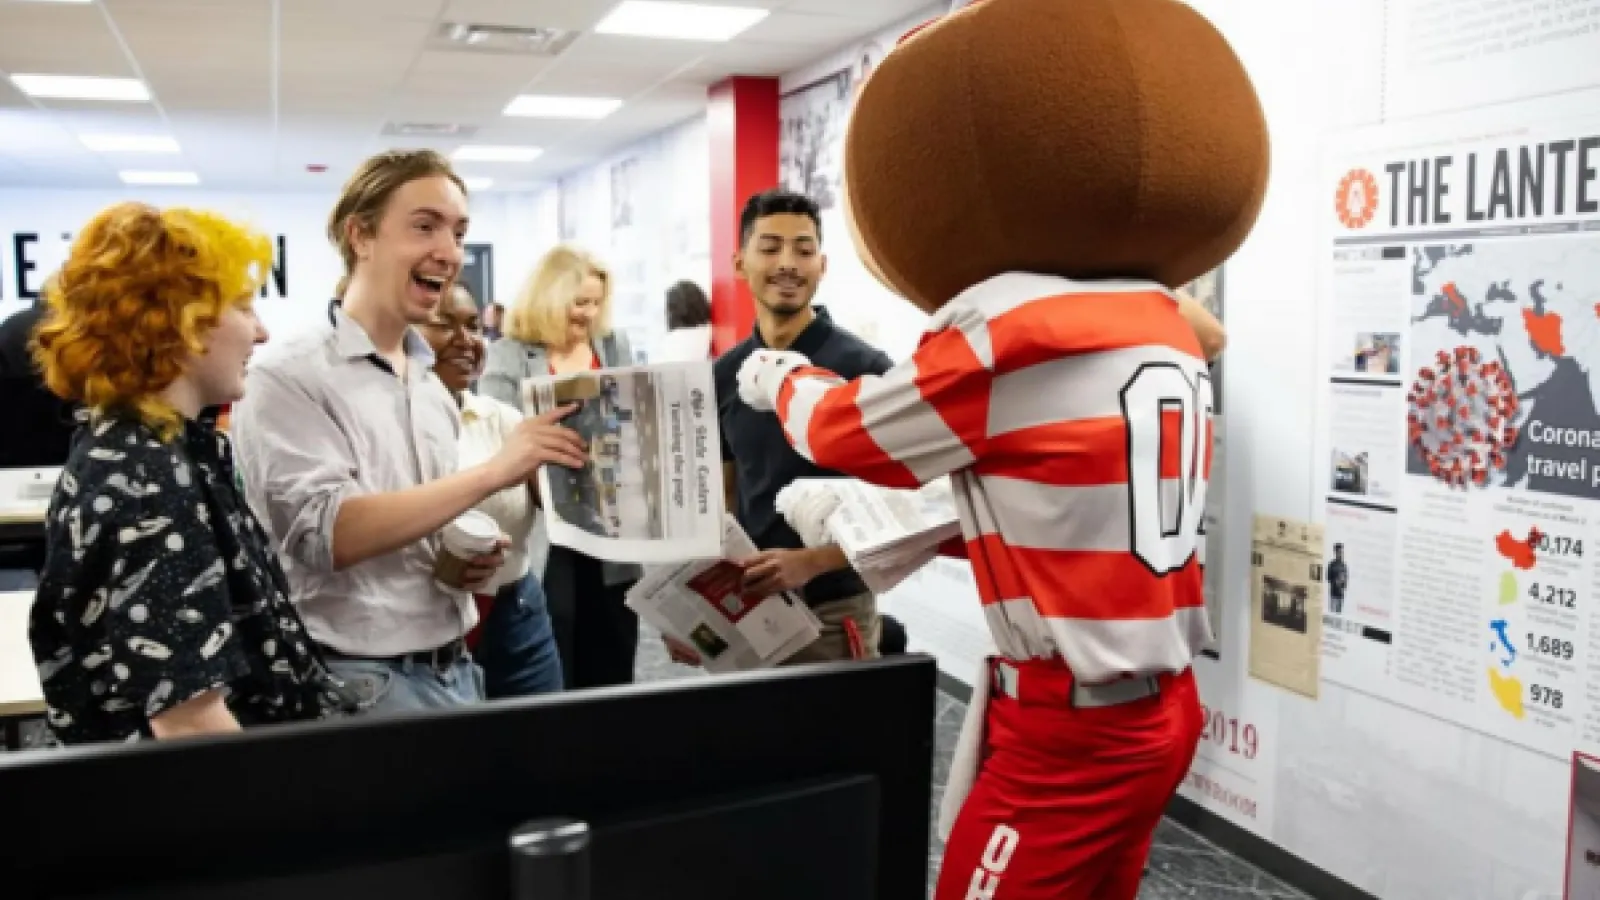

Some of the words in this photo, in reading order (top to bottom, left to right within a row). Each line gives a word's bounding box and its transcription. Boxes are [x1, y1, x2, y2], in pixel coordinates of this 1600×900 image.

[1384, 155, 1453, 228] THE
[1466, 135, 1600, 222] LANTE
[670, 402, 683, 453] Turning
[1527, 419, 1600, 447] Corona
[674, 454, 685, 474] the
[1526, 454, 1587, 480] travel
[671, 478, 684, 509] page
[1530, 683, 1564, 709] 978
[1199, 706, 1258, 760] 2019
